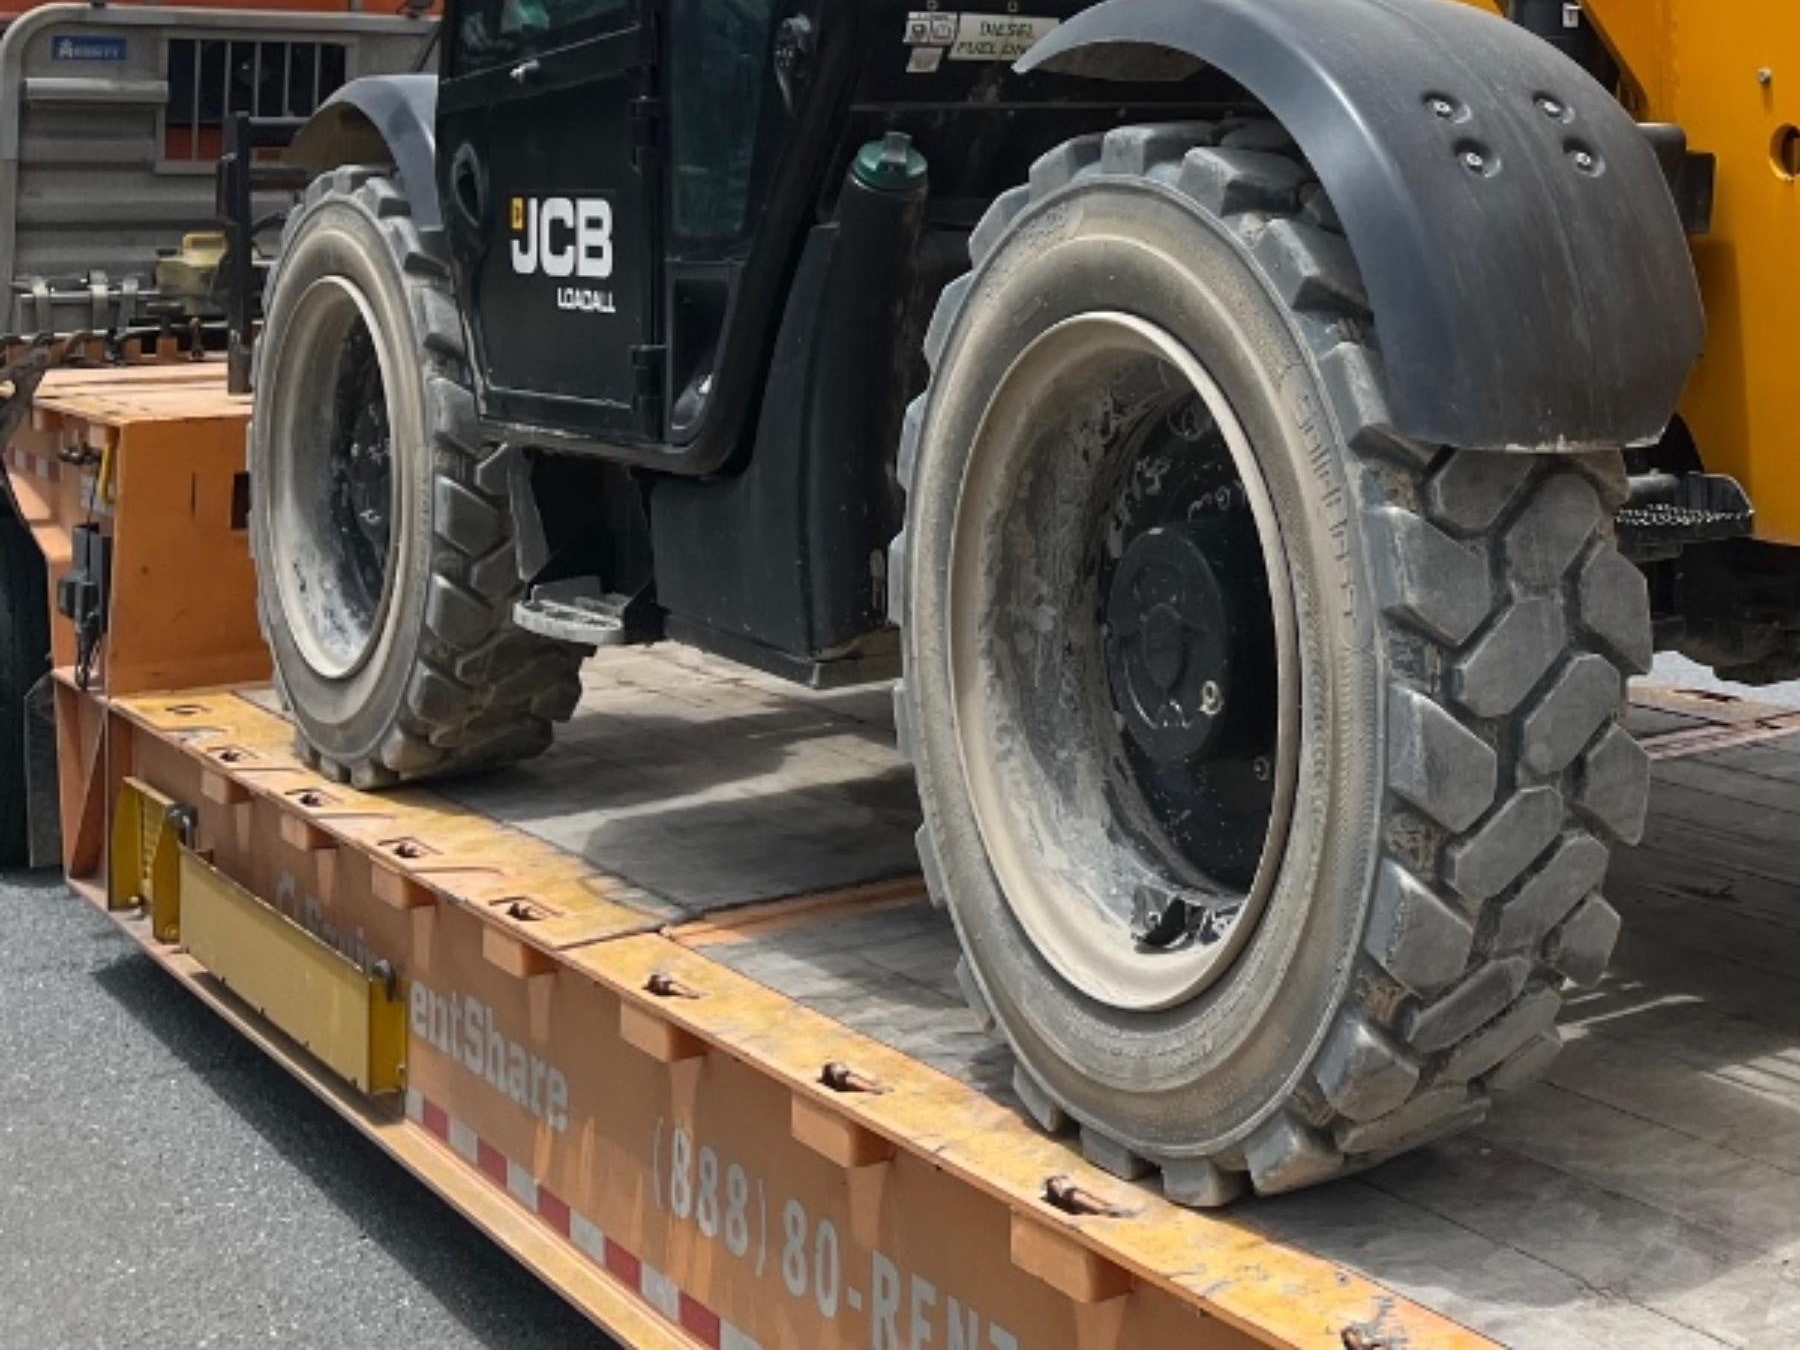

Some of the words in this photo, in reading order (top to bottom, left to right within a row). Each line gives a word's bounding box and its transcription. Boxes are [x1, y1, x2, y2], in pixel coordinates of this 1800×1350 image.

[510, 197, 613, 278] JCB
[557, 287, 616, 313] LOADALL
[410, 979, 569, 1132] entShare
[652, 1115, 767, 1278] (888)
